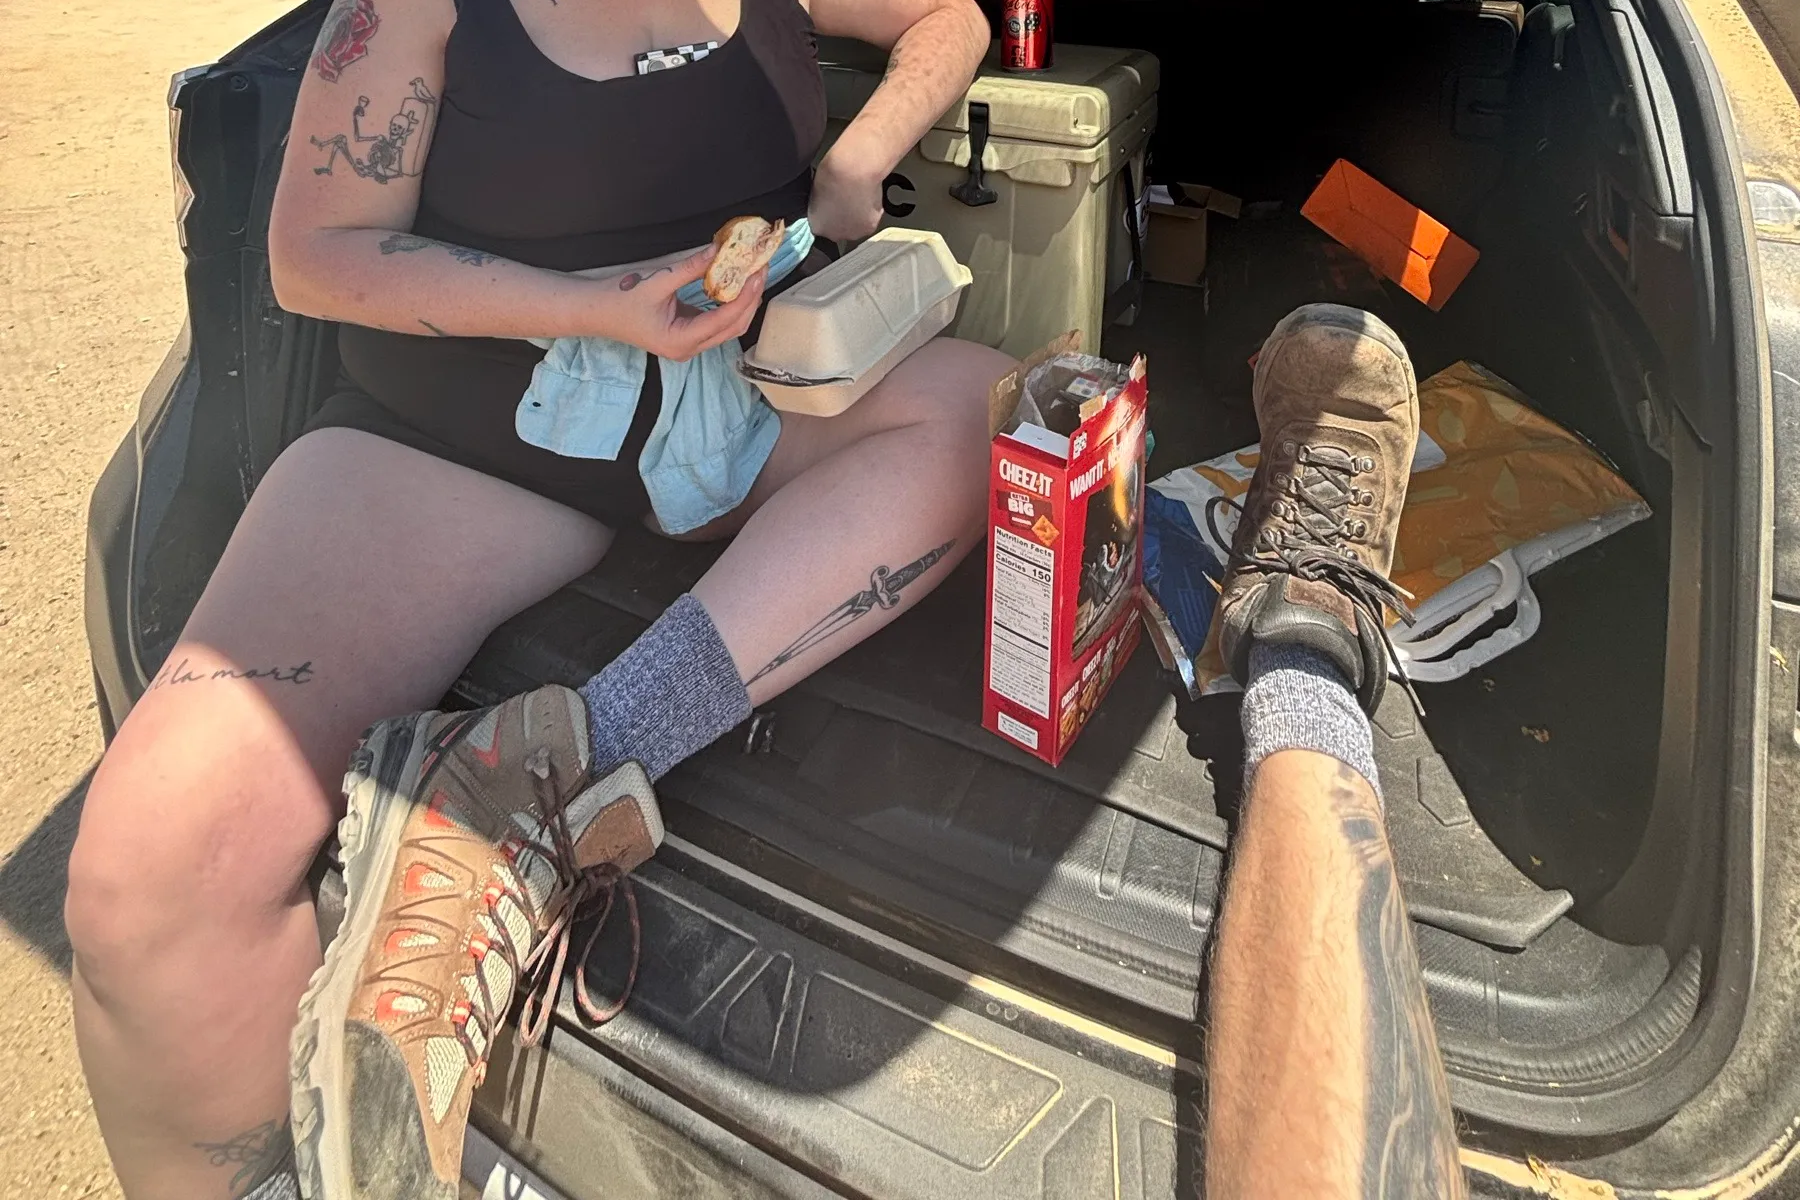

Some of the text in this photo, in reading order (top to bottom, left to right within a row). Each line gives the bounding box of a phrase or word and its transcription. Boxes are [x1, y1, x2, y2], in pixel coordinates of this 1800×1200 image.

[1008, 498, 1034, 517] BIG
[996, 528, 1029, 548] Nutrition
[1030, 543, 1052, 558] Facts
[996, 553, 1026, 573] Calories
[1033, 568, 1051, 583] 150
